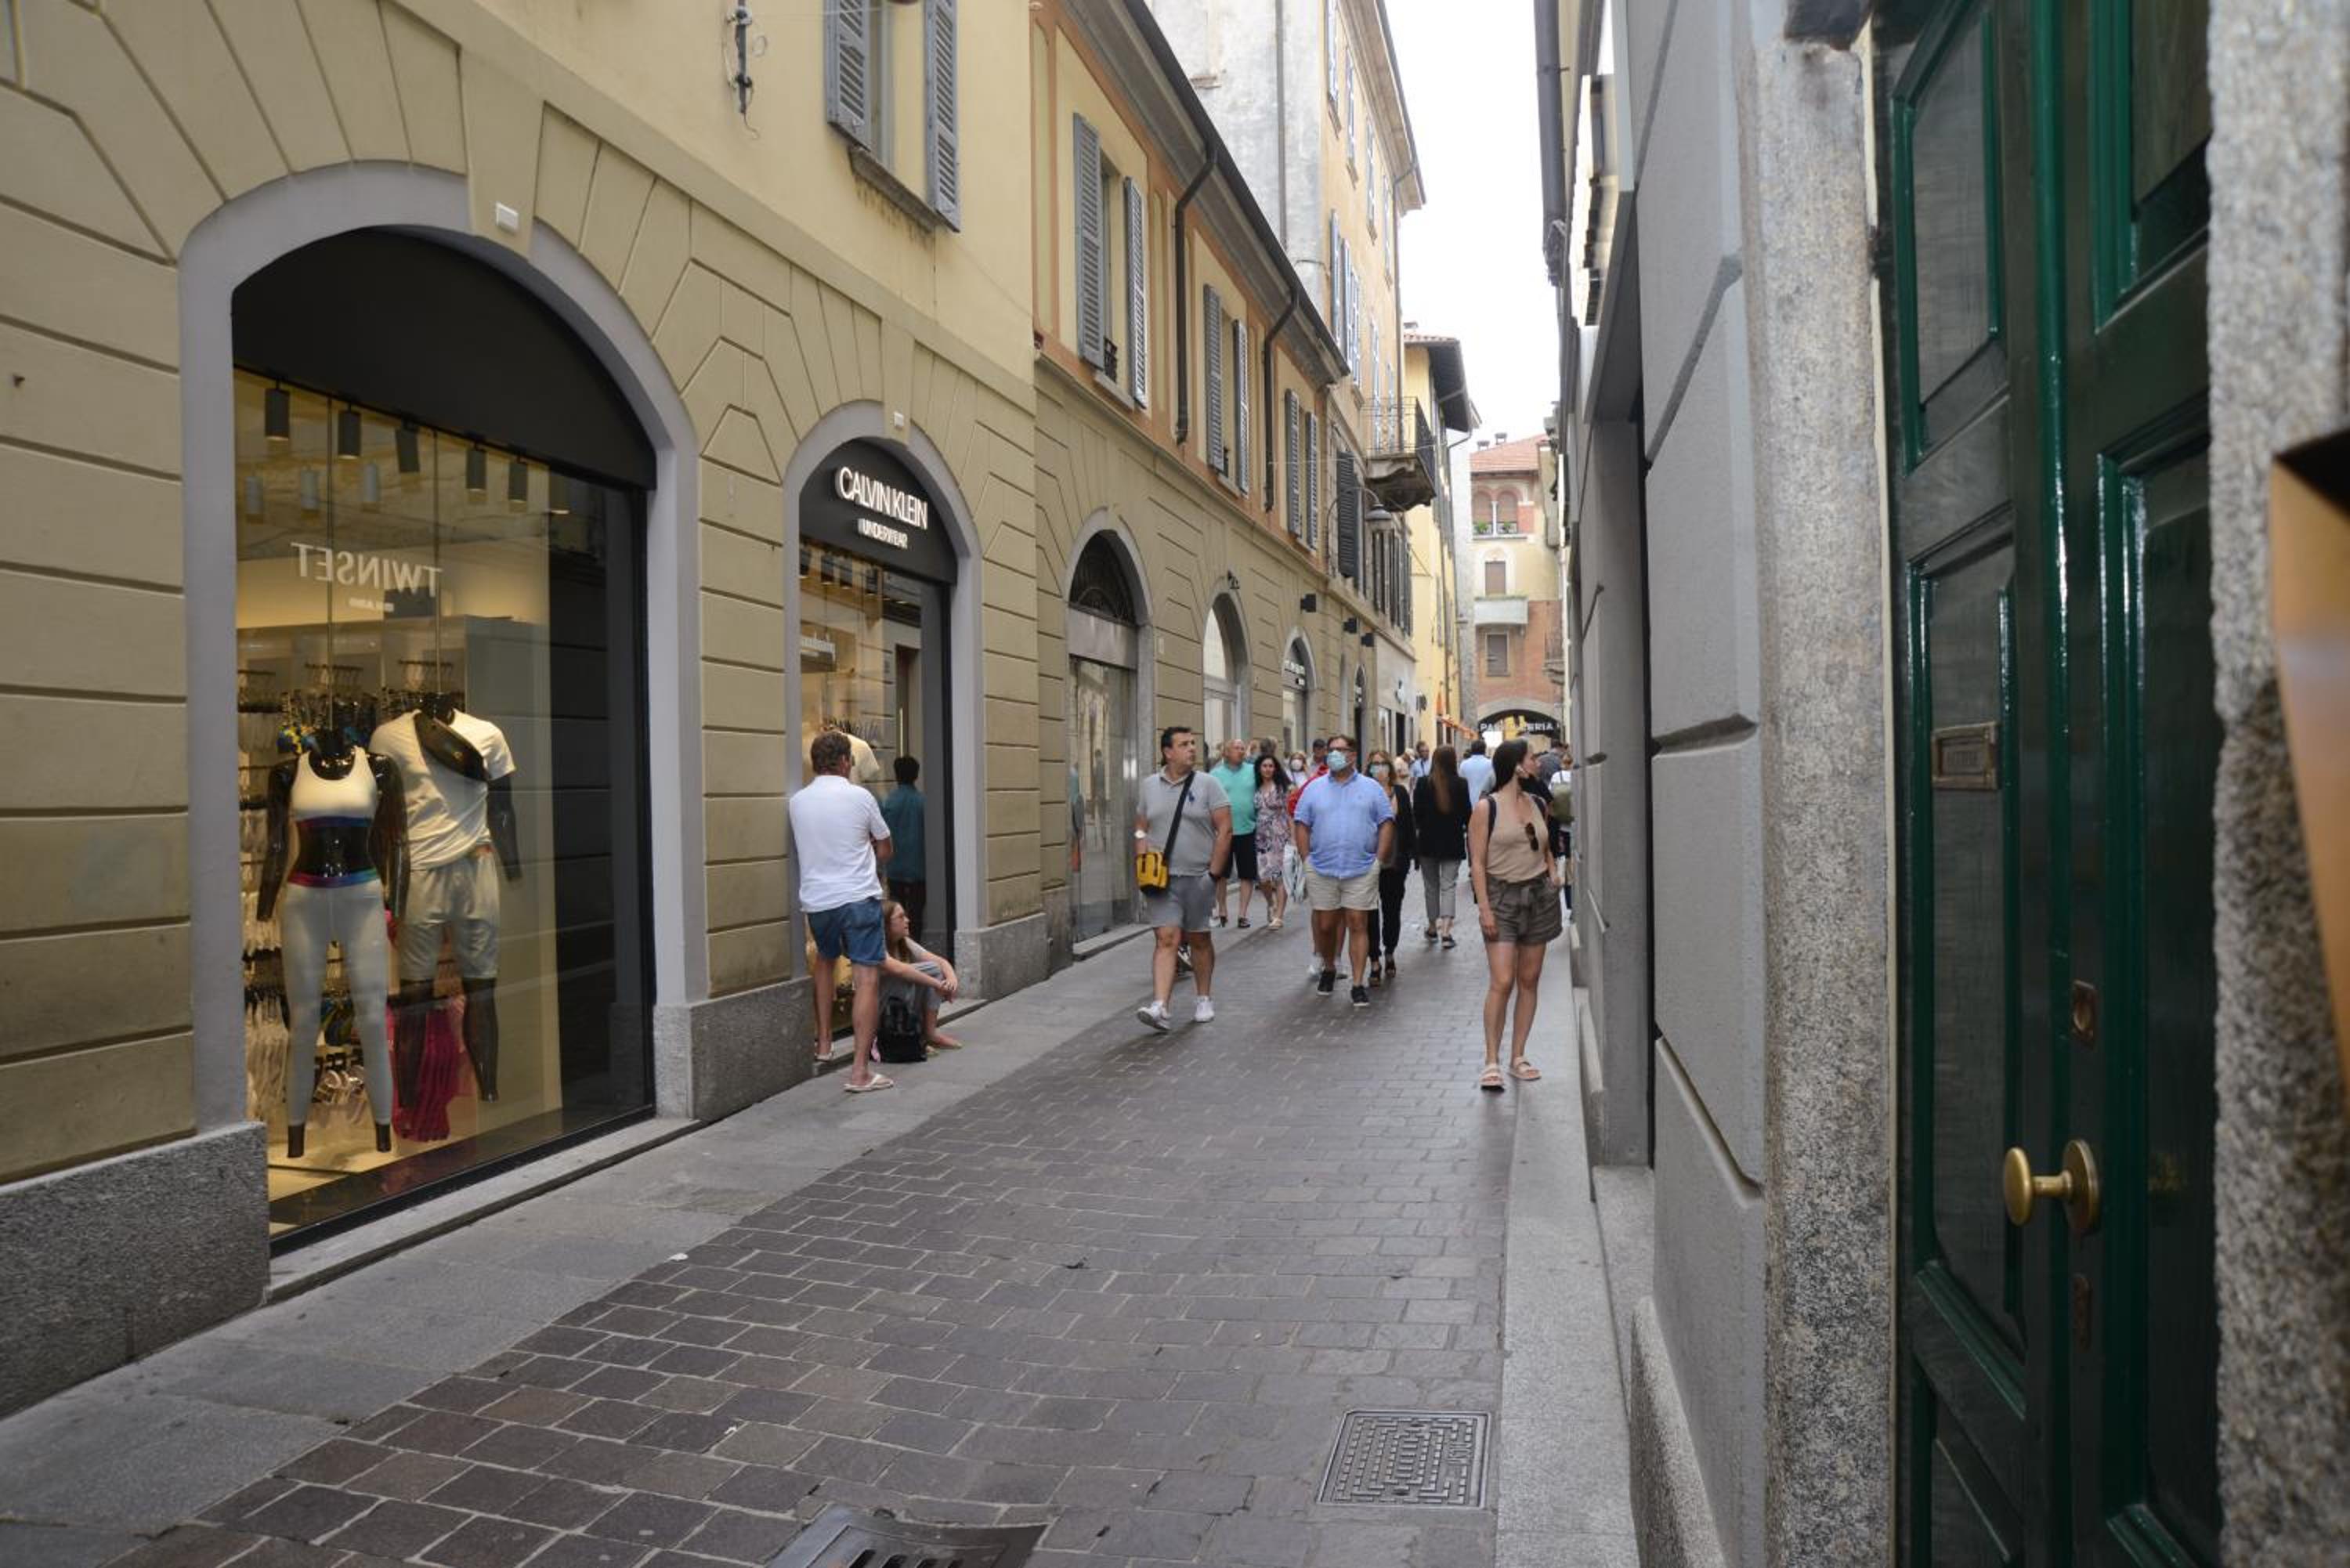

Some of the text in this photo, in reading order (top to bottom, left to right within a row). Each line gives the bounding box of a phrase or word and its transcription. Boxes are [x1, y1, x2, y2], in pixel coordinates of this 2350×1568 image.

[836, 466, 928, 530] CALVIN KLEIN
[859, 518, 908, 549] UNDERWEAR
